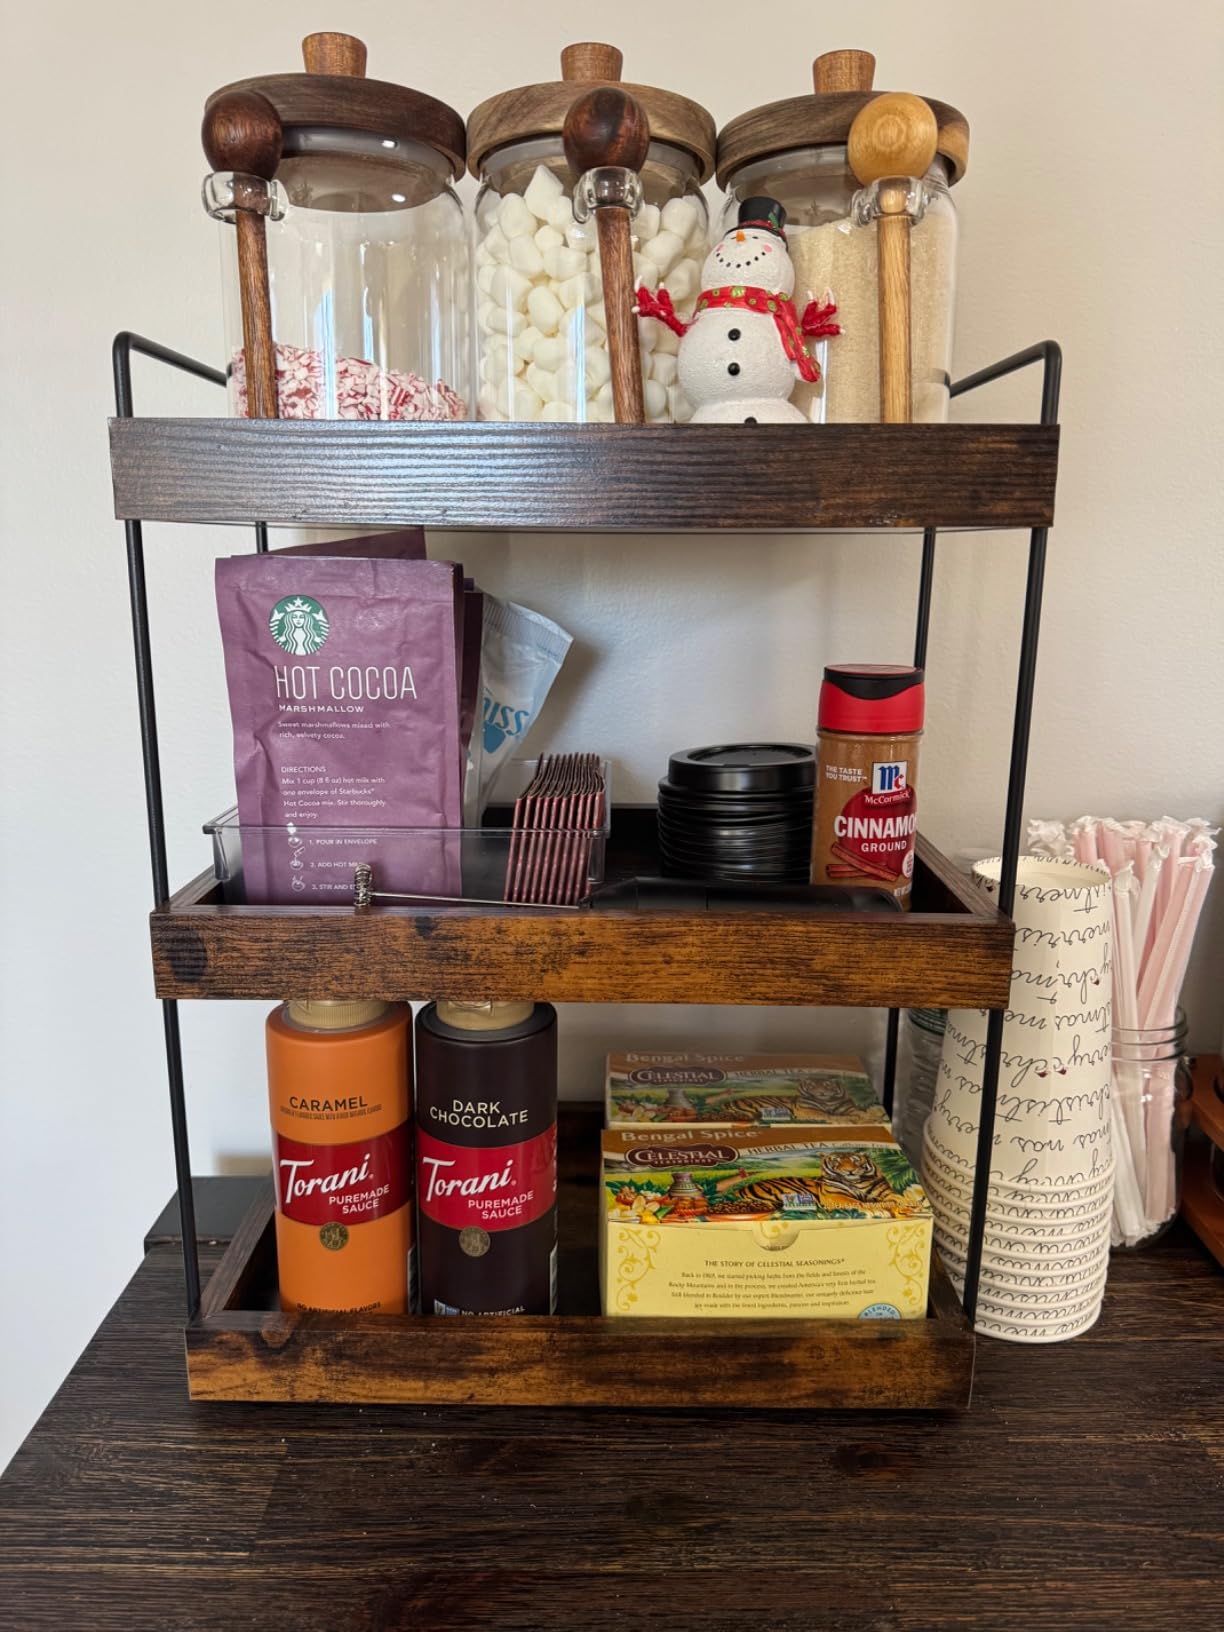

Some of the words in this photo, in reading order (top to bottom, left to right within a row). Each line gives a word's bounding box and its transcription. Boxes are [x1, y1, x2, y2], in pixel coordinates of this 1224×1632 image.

[274, 665, 320, 700] HOT
[329, 666, 417, 700] COCOA
[278, 704, 365, 713] MARSHMALLOW
[301, 721, 350, 729] marshmallows
[826, 765, 837, 773] THE
[838, 767, 863, 775] TASTE
[826, 772, 838, 780] YOU
[297, 788, 329, 796] envelope
[864, 791, 909, 805] McCormick
[833, 813, 917, 839] CINNAMO
[861, 840, 907, 852] GROUND
[626, 1053, 688, 1063] Bengal
[697, 1052, 744, 1063] Spice
[636, 1069, 720, 1080] CELESTIAL
[289, 1096, 368, 1112] CARAMEL
[453, 1100, 501, 1114] DARK
[429, 1106, 529, 1128] CHOCOLATE
[621, 1130, 693, 1144] Bengal
[633, 1148, 730, 1161] CELESTIAL
[747, 1144, 797, 1154] HERBAL
[279, 1153, 370, 1204] Torani
[422, 1156, 514, 1202] Torani
[328, 1184, 390, 1205] PUREMADE
[468, 1190, 534, 1209] PUREMADE
[342, 1199, 380, 1214] SAUCE
[481, 1205, 522, 1220] SAUCE
[757, 1260, 794, 1268] CELESTIAL
[863, 1305, 896, 1317] BLENDED
